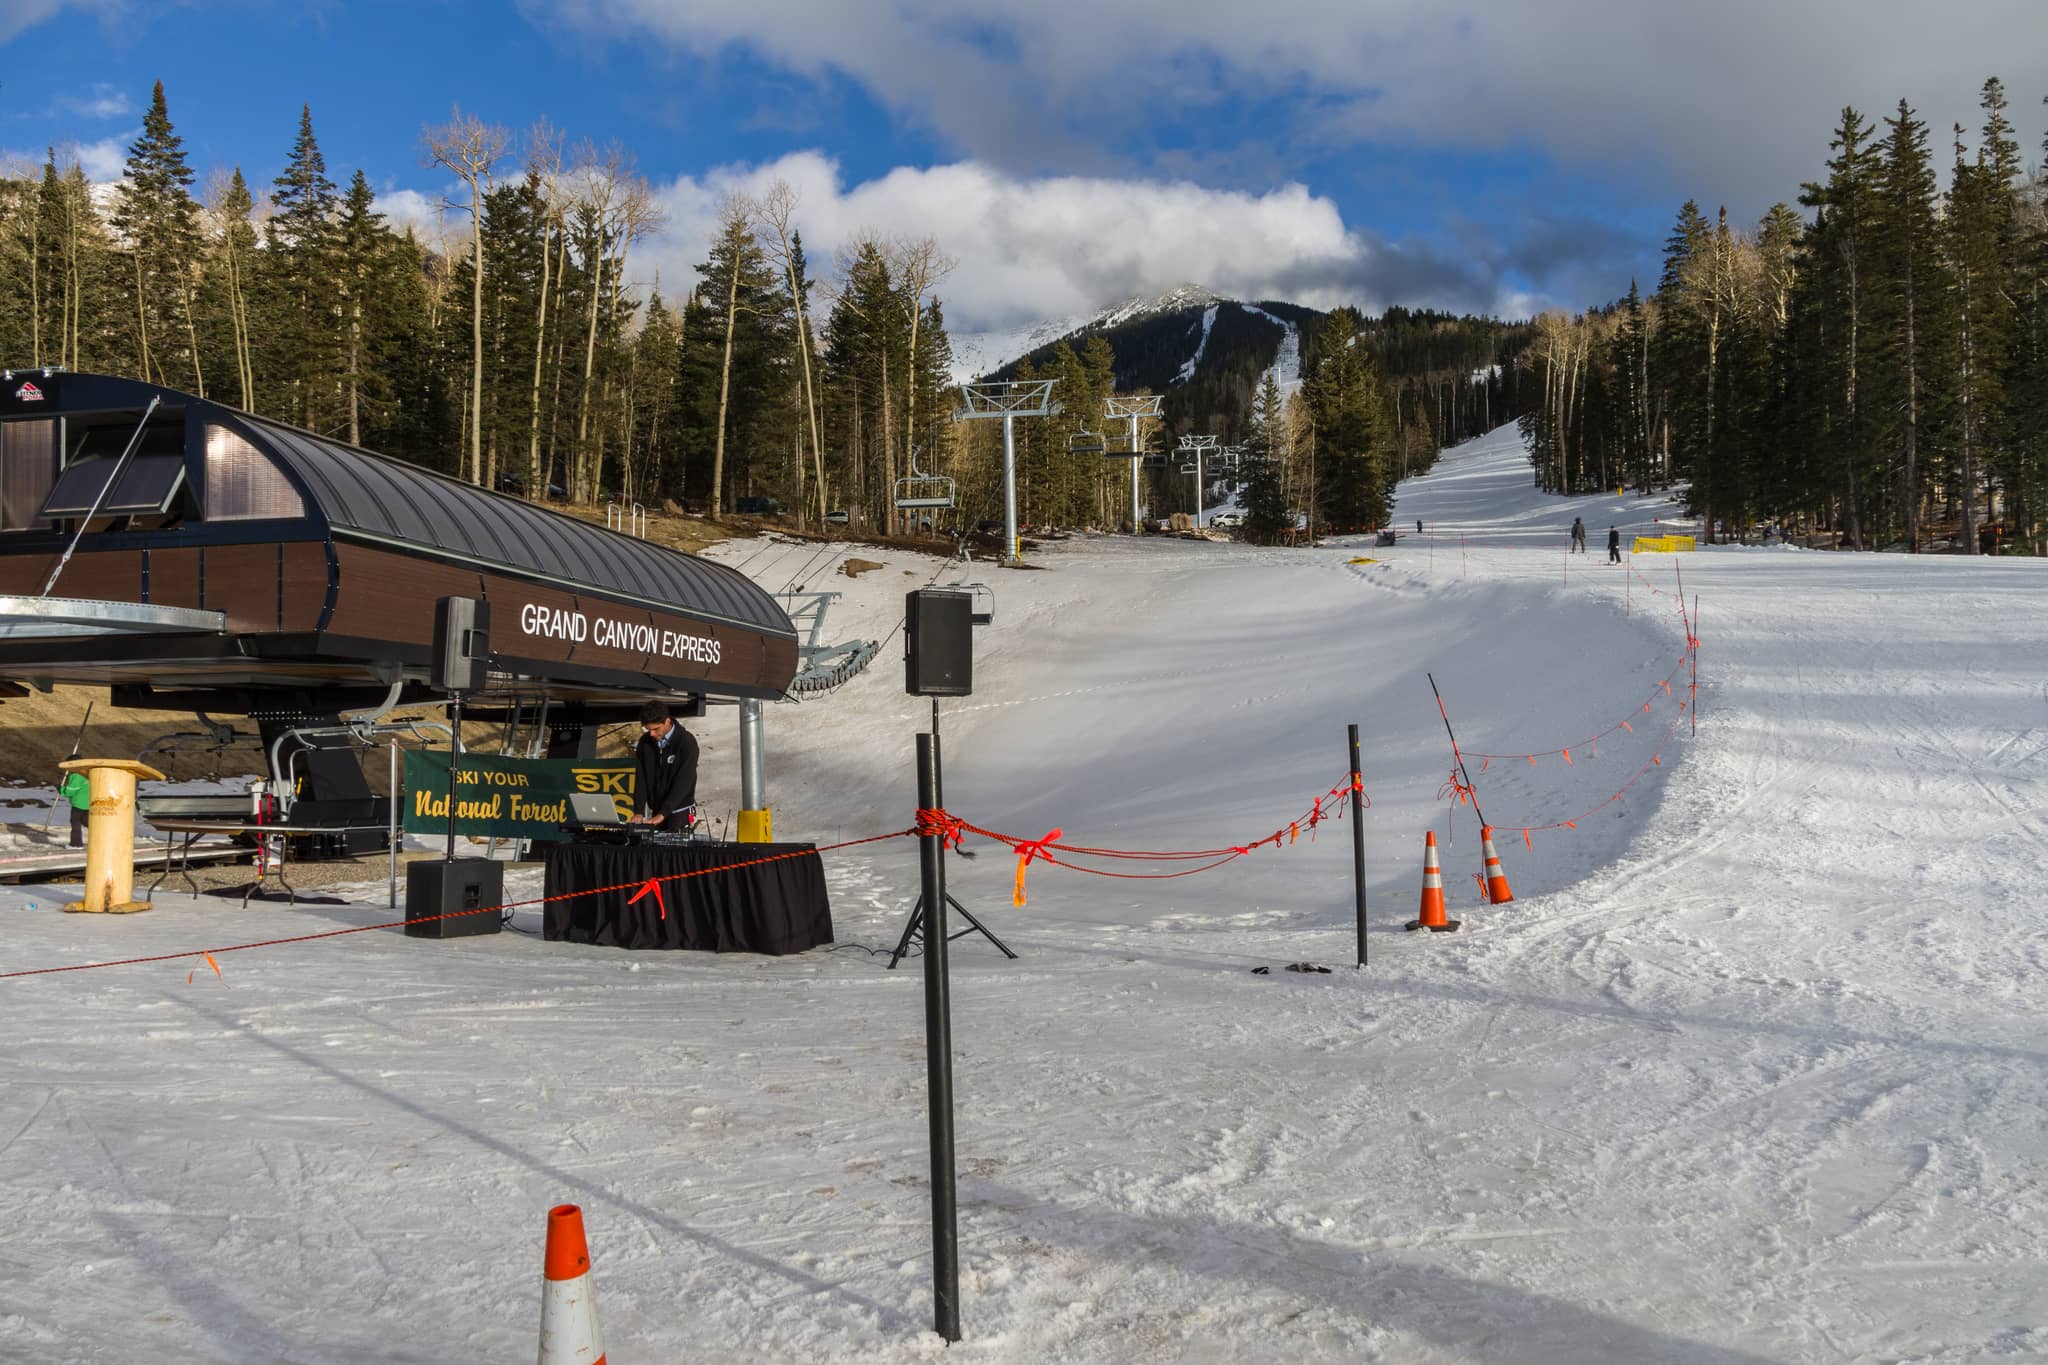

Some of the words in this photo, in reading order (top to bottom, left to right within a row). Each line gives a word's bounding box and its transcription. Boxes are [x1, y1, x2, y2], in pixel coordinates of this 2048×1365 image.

[521, 603, 587, 642] GRAND
[594, 617, 658, 654] CANYON
[662, 630, 721, 665] EXPRESS
[455, 770, 478, 785] SKI
[484, 771, 529, 787] YOUR
[575, 773, 636, 794] SKI
[415, 790, 502, 819] Natonal
[510, 794, 568, 823] Forest
